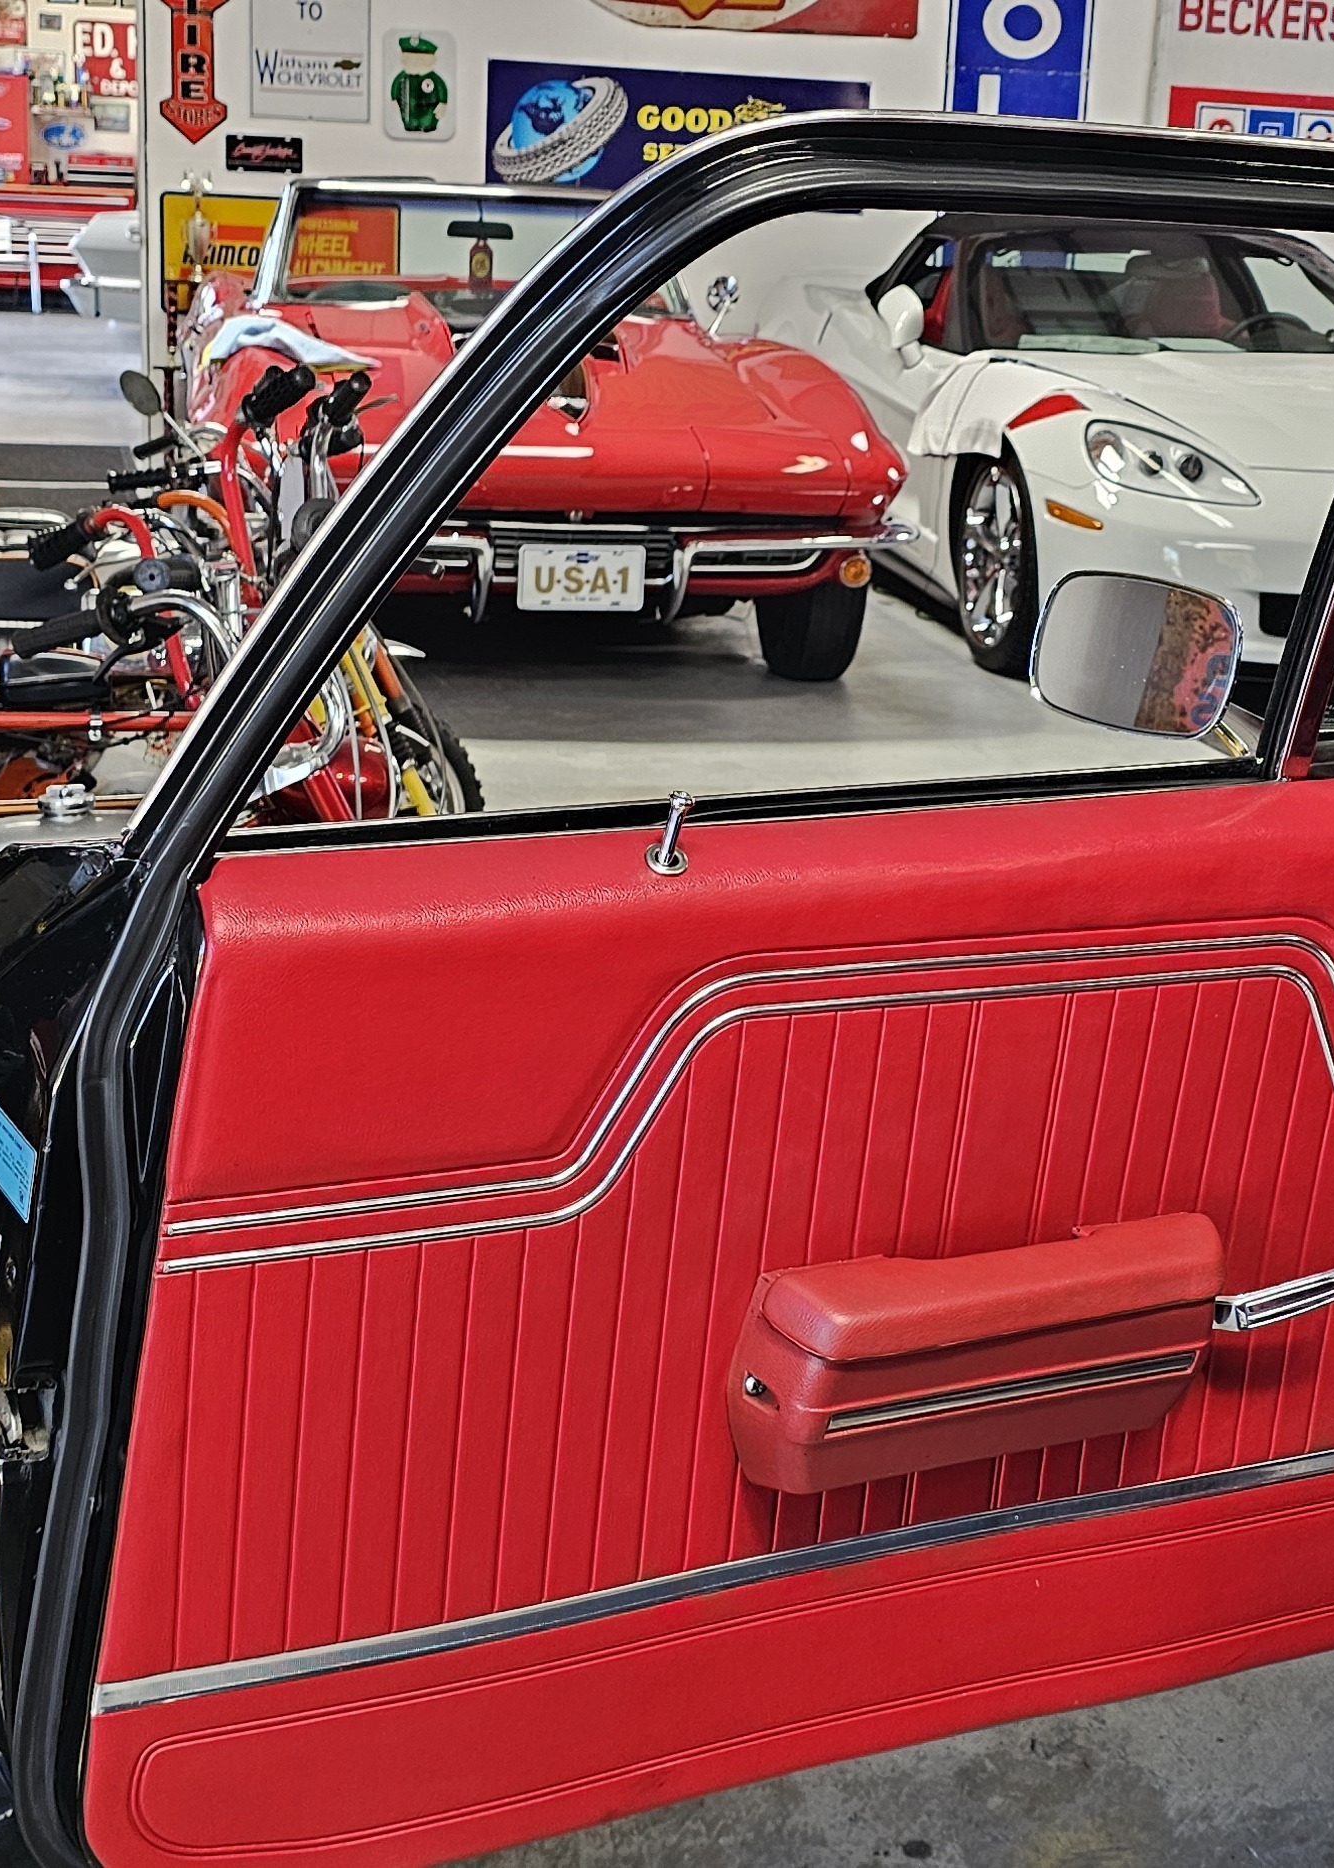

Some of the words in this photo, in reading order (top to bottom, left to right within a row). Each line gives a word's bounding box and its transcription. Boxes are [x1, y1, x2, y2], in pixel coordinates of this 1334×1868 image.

[296, 1, 323, 21] TO
[277, 71, 362, 89] CHEVROLET
[636, 104, 734, 134] GOOD
[298, 233, 353, 258] WHEEL
